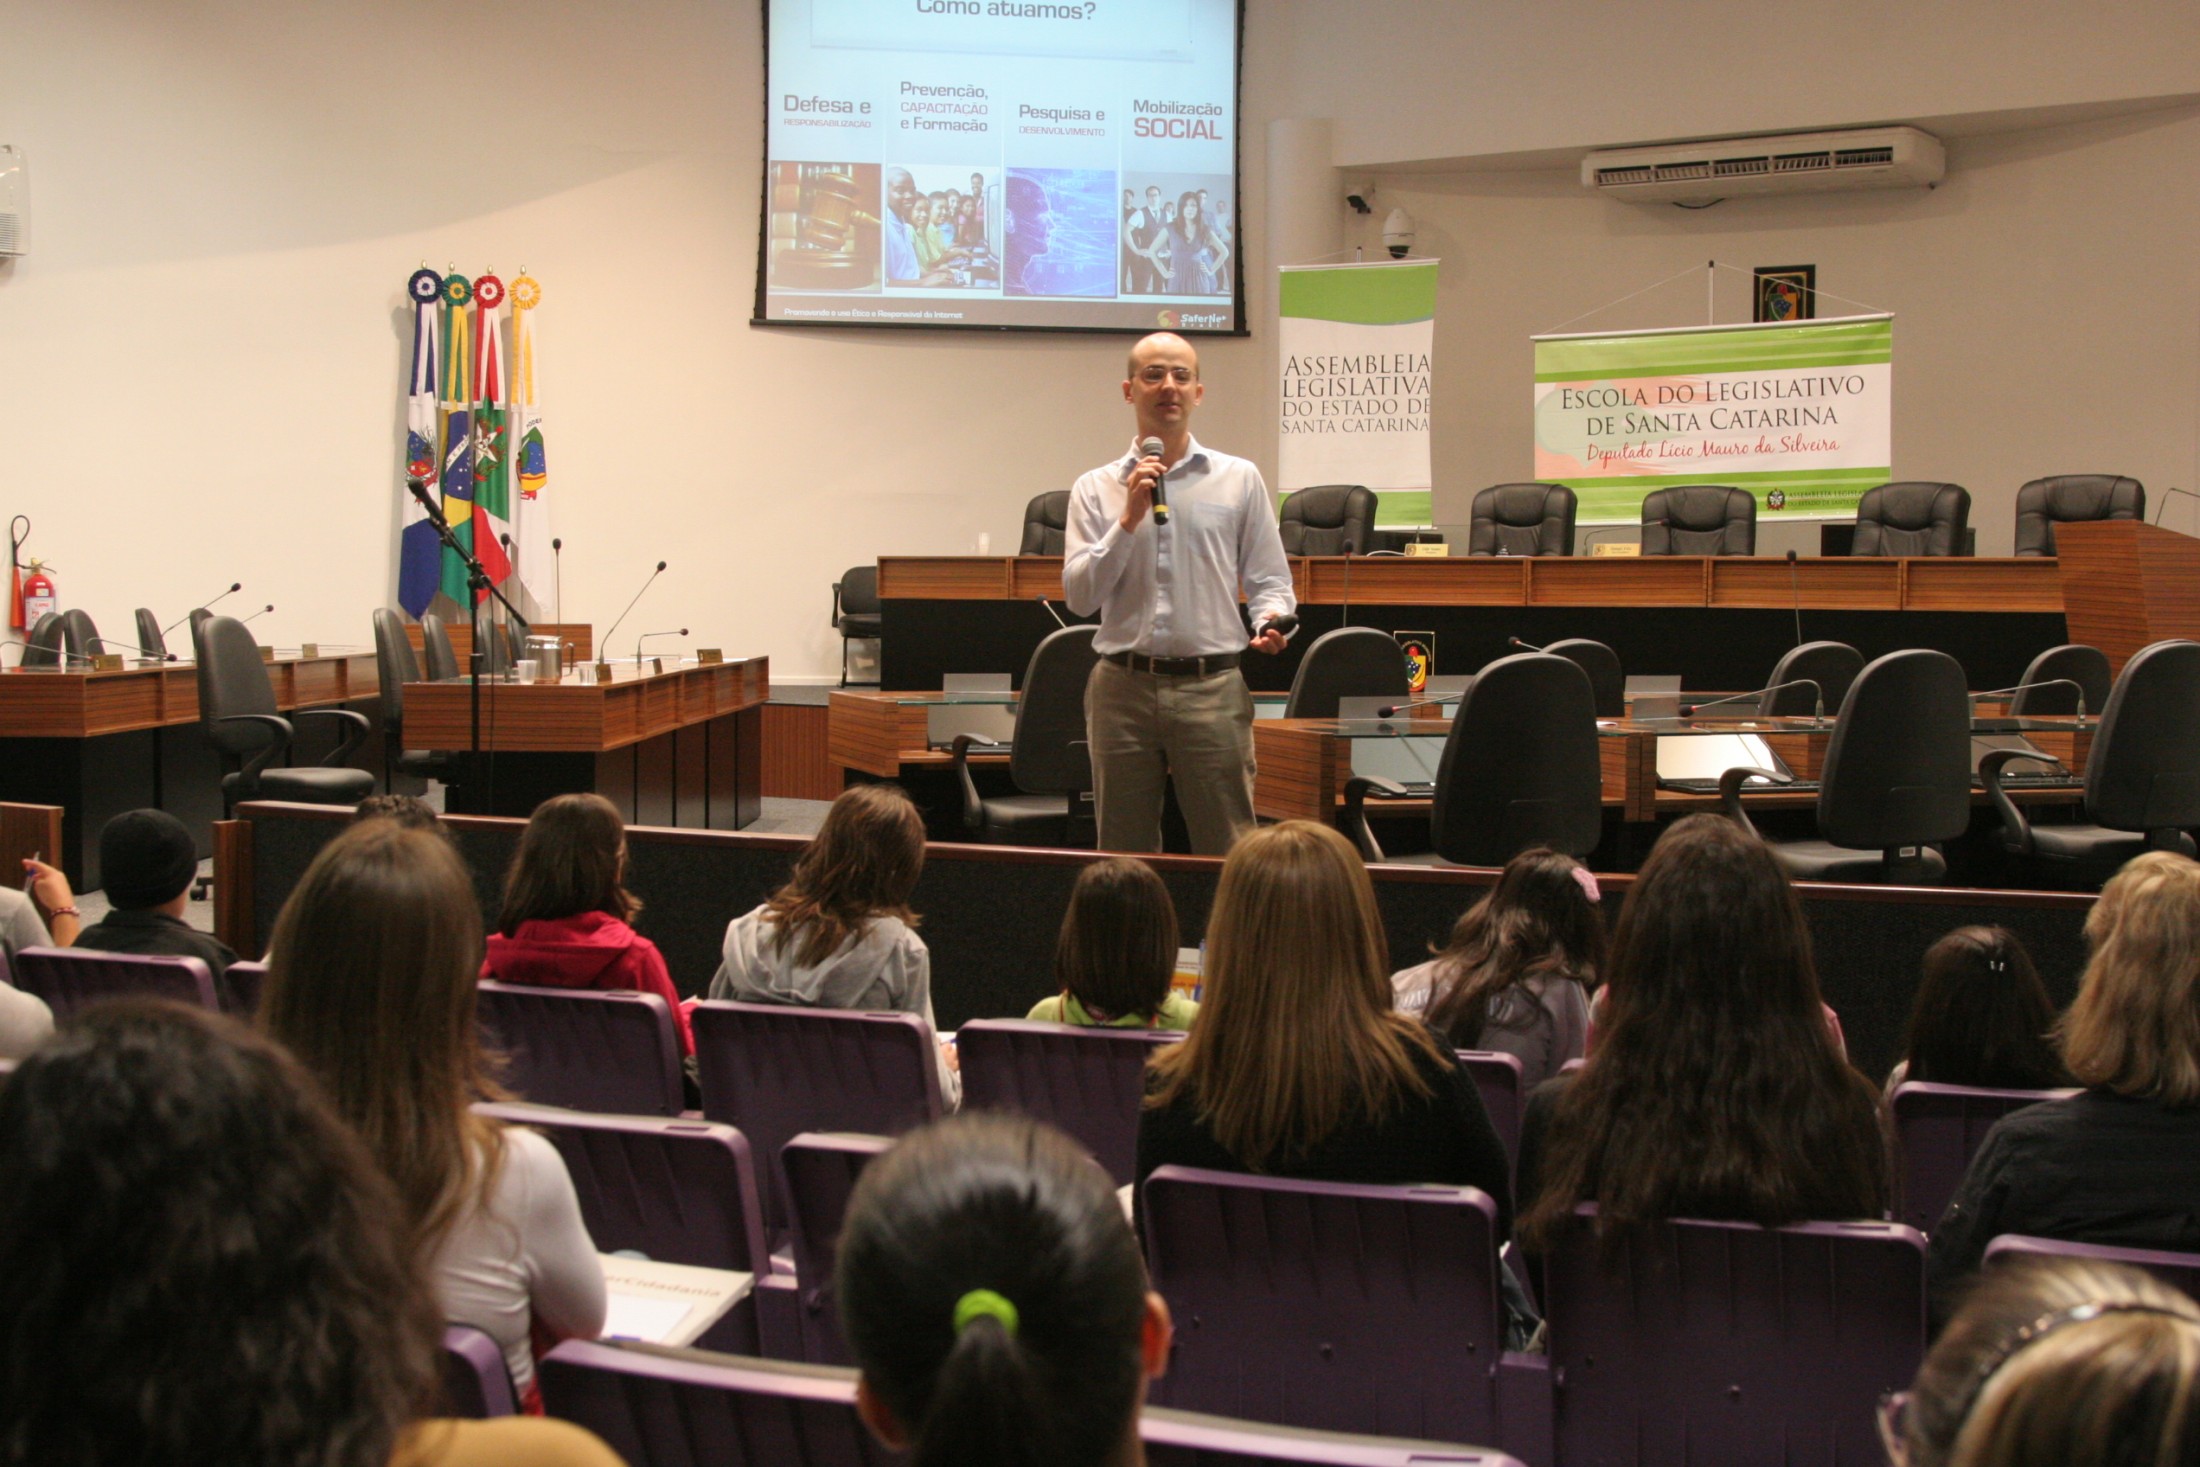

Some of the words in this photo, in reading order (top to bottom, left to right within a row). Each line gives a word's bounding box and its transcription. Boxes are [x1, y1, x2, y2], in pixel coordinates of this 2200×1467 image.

[987, 0, 1096, 20] atuamos?
[784, 95, 853, 114] Defesa
[859, 101, 872, 114] e
[900, 102, 988, 116] CAPACITAÇÃO
[1019, 104, 1091, 123] Pesquisa
[1096, 110, 1105, 121] e
[1133, 99, 1223, 118] Mobilização
[900, 119, 909, 129] e
[914, 117, 988, 133] Formação
[1019, 125, 1105, 137] DESENVOLVIMENTO
[1134, 117, 1223, 140] SOCIAL
[934, 310, 963, 319] Internet
[1284, 354, 1431, 376] ASSEMBLEIA
[1282, 376, 1430, 398] LEGISLATIVA
[1561, 387, 1649, 410] ESCOLA
[1657, 384, 1695, 406] DO
[1705, 375, 1865, 403] LEGISLATIVO
[1282, 401, 1313, 417] DO
[1321, 398, 1398, 416] ESTADO
[1407, 397, 1430, 415] DE
[1281, 418, 1336, 434] SANTA
[1342, 418, 1429, 433] CATARINA
[1586, 417, 1615, 436] DE
[1624, 411, 1701, 434] SANTA
[1709, 406, 1838, 431] CATARINA
[1587, 443, 1653, 470] Deputado
[1658, 440, 1694, 459] Lício
[1698, 438, 1749, 458] Mauro
[1754, 435, 1774, 454] da
[1780, 432, 1840, 453] Silveira
